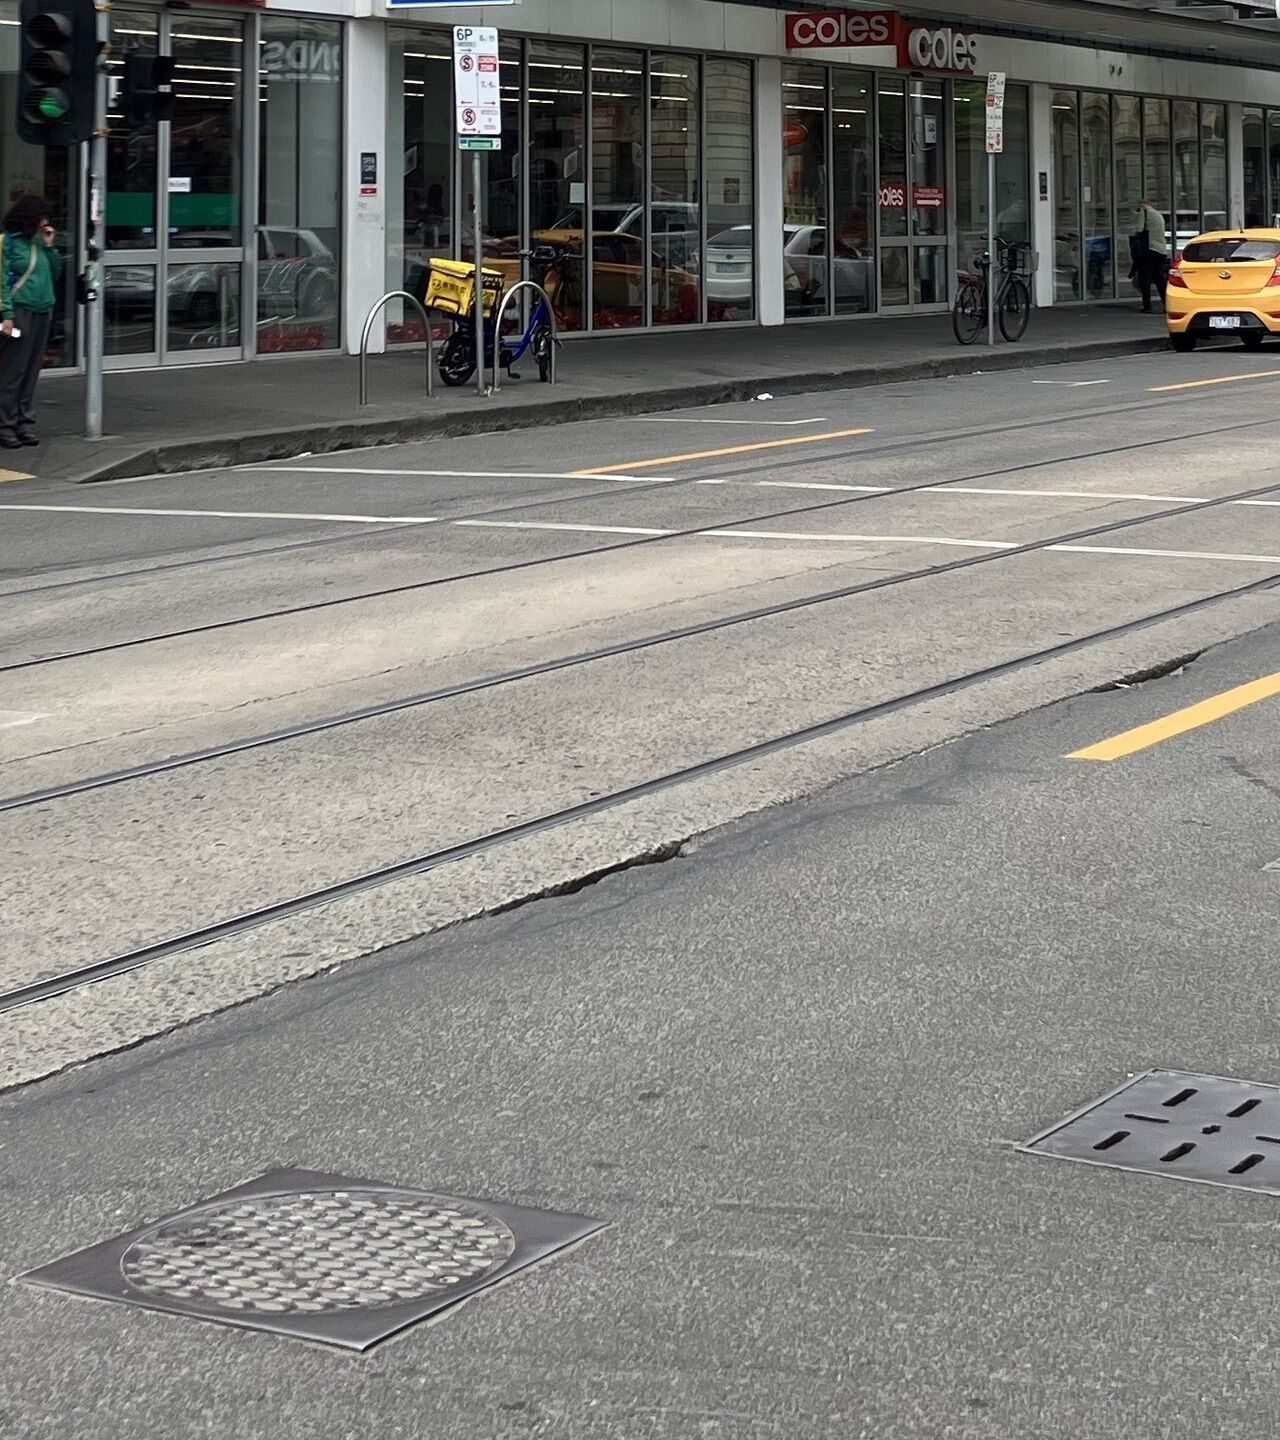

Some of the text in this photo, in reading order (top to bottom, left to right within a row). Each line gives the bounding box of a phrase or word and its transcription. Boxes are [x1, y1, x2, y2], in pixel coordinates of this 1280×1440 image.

[457, 28, 473, 41] 6P
[793, 13, 889, 45] coles
[910, 27, 978, 71] coles
